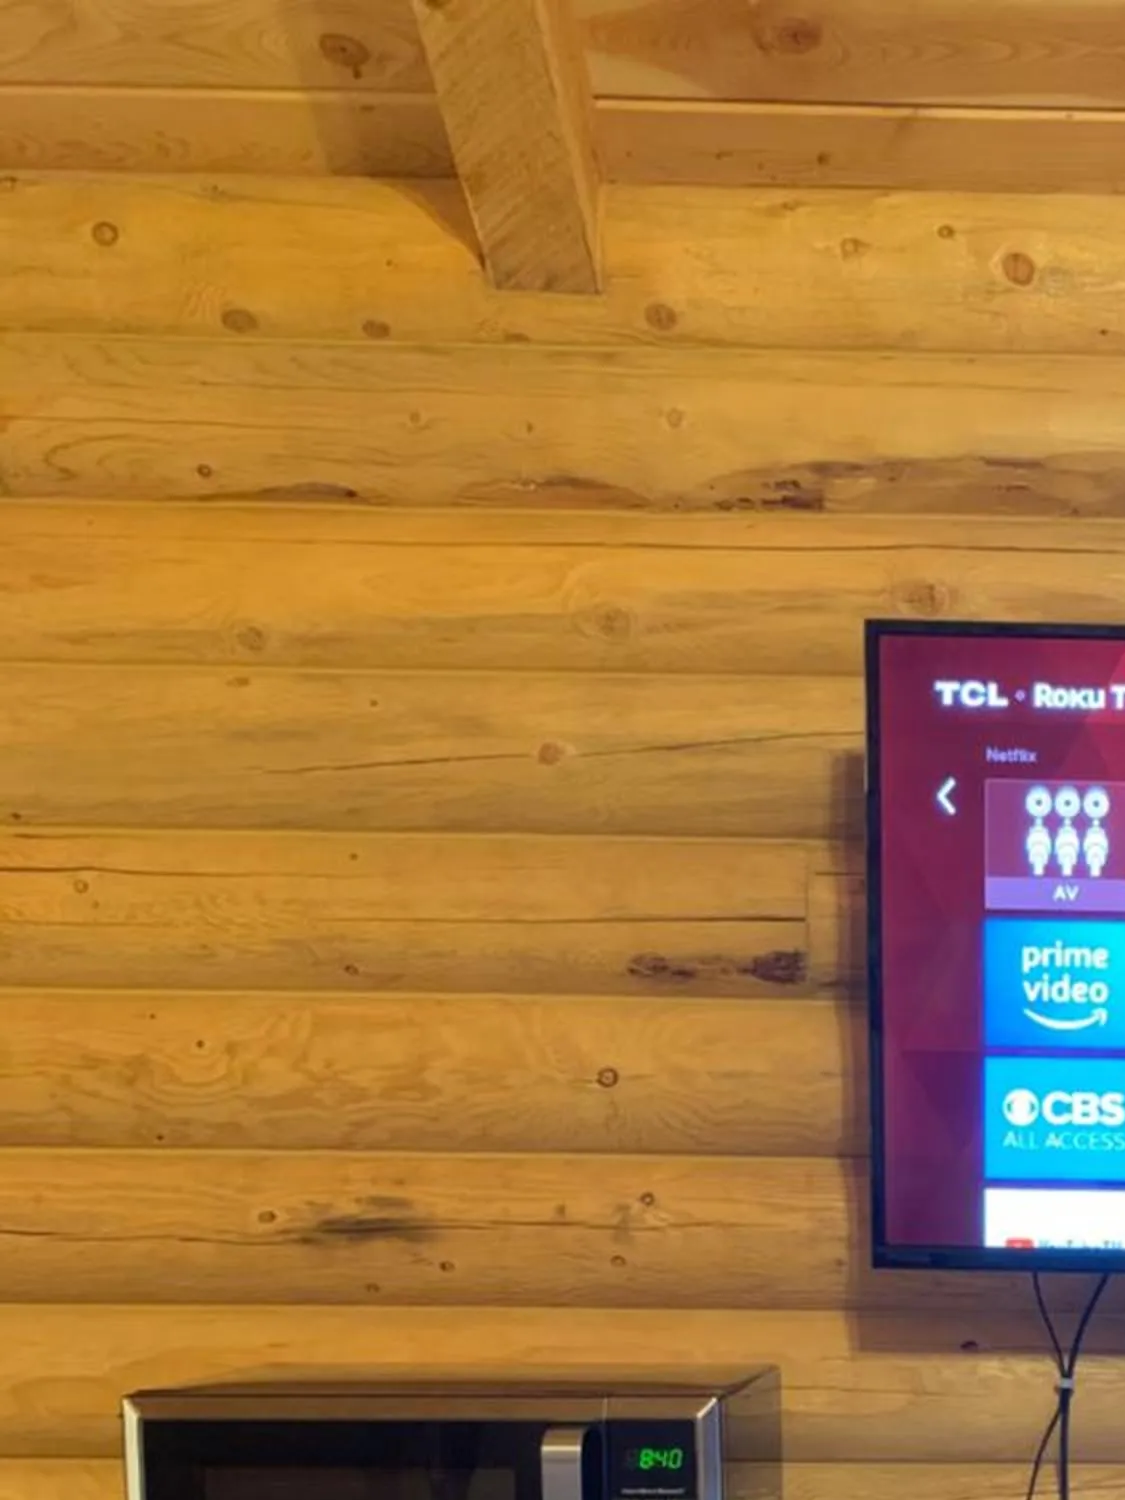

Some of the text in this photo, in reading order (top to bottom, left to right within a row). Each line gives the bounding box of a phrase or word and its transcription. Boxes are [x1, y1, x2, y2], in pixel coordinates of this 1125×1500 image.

[934, 680, 1009, 708] TCL
[1032, 681, 1105, 710] Roku
[985, 747, 1037, 763] Netflix
[1053, 884, 1080, 902] AV
[1022, 941, 1109, 974] prime
[1022, 973, 1110, 1004] video
[1003, 1131, 1039, 1150] ALL
